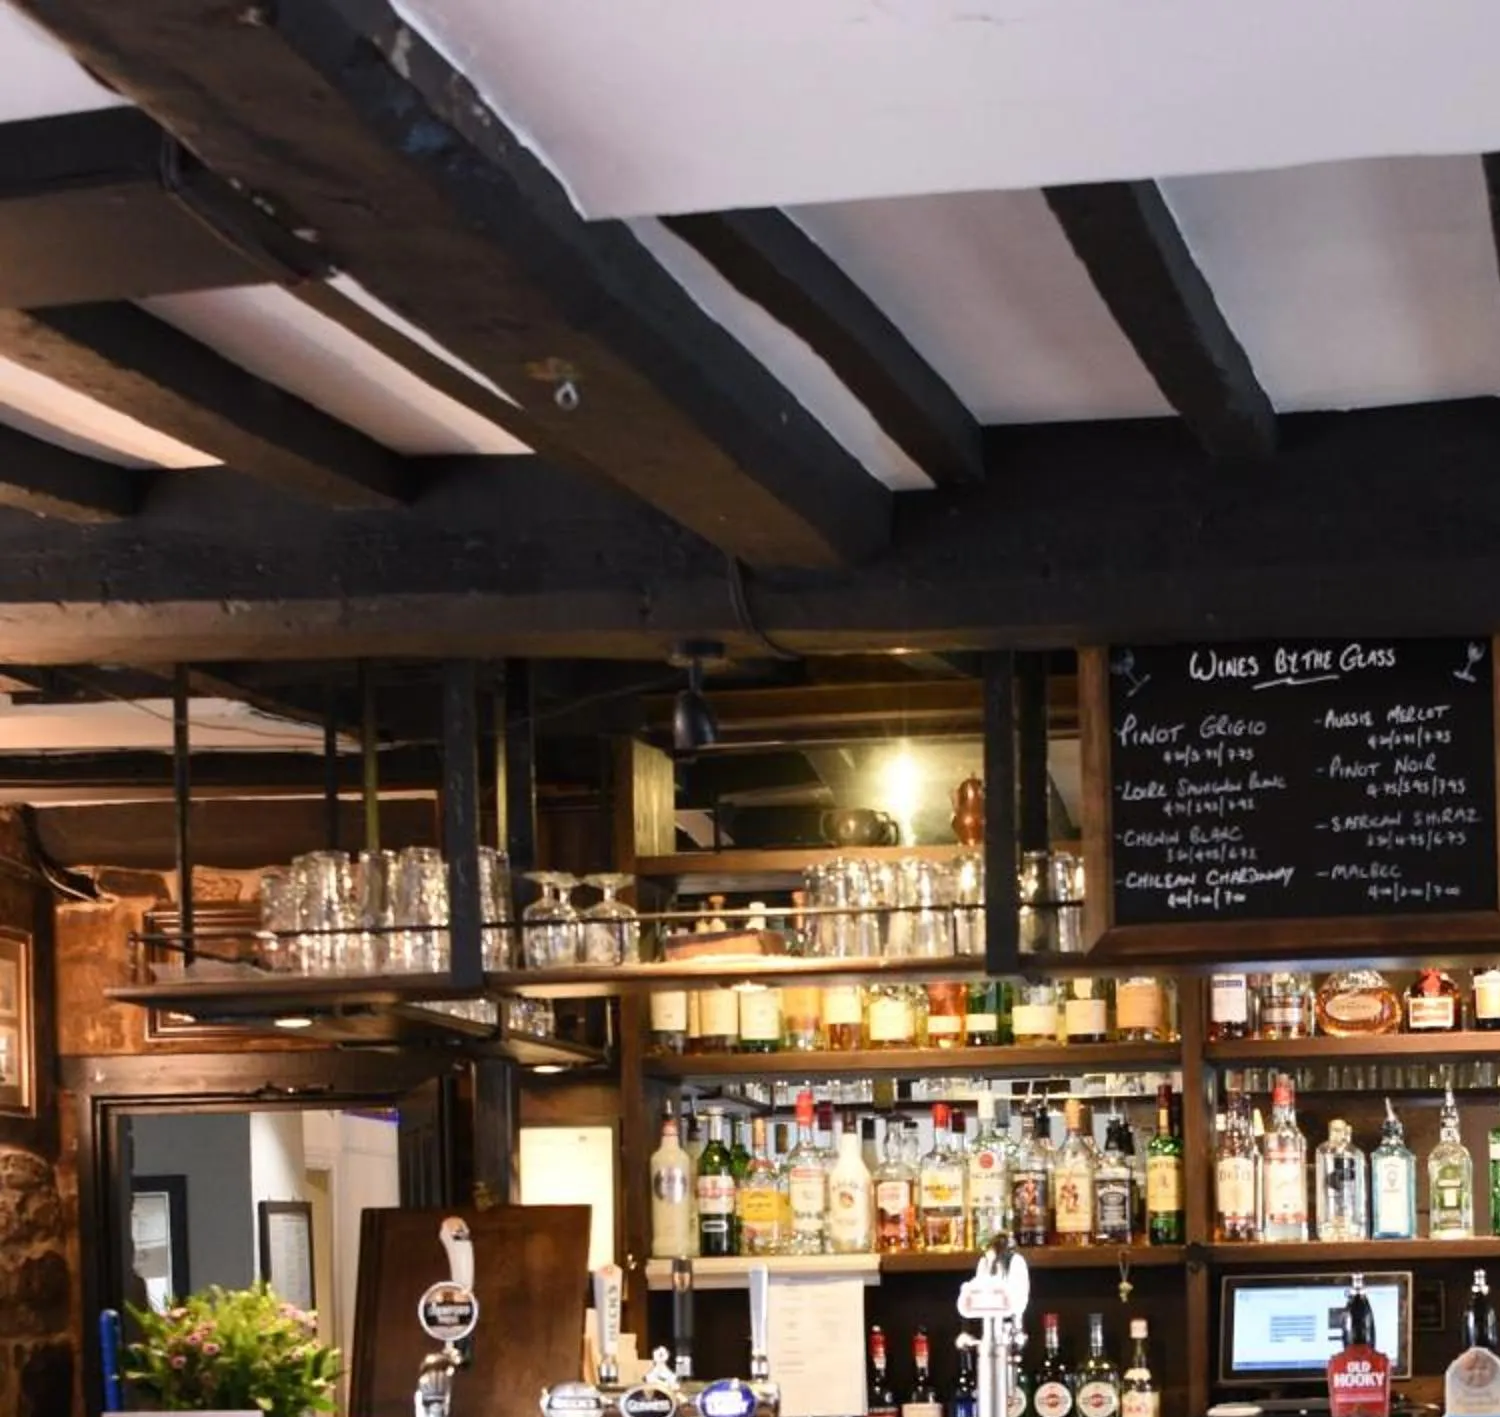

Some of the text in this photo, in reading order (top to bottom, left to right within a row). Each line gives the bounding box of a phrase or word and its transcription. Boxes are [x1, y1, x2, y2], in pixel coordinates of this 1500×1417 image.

[1189, 643, 1396, 681] WINES BY THE GLASS
[1386, 704, 1451, 725] MERLOT
[1119, 713, 1267, 747] PINOT GRIGIO
[1329, 752, 1437, 779] PINOT NOIR
[1412, 806, 1482, 827] SHIRAZ
[1123, 825, 1244, 847] CHENIN BLANC
[1125, 870, 1197, 889] CHILEAN
[1331, 862, 1402, 880] MALBEC
[1346, 1360, 1371, 1373] OLD
[1333, 1372, 1385, 1388] HOOKY
